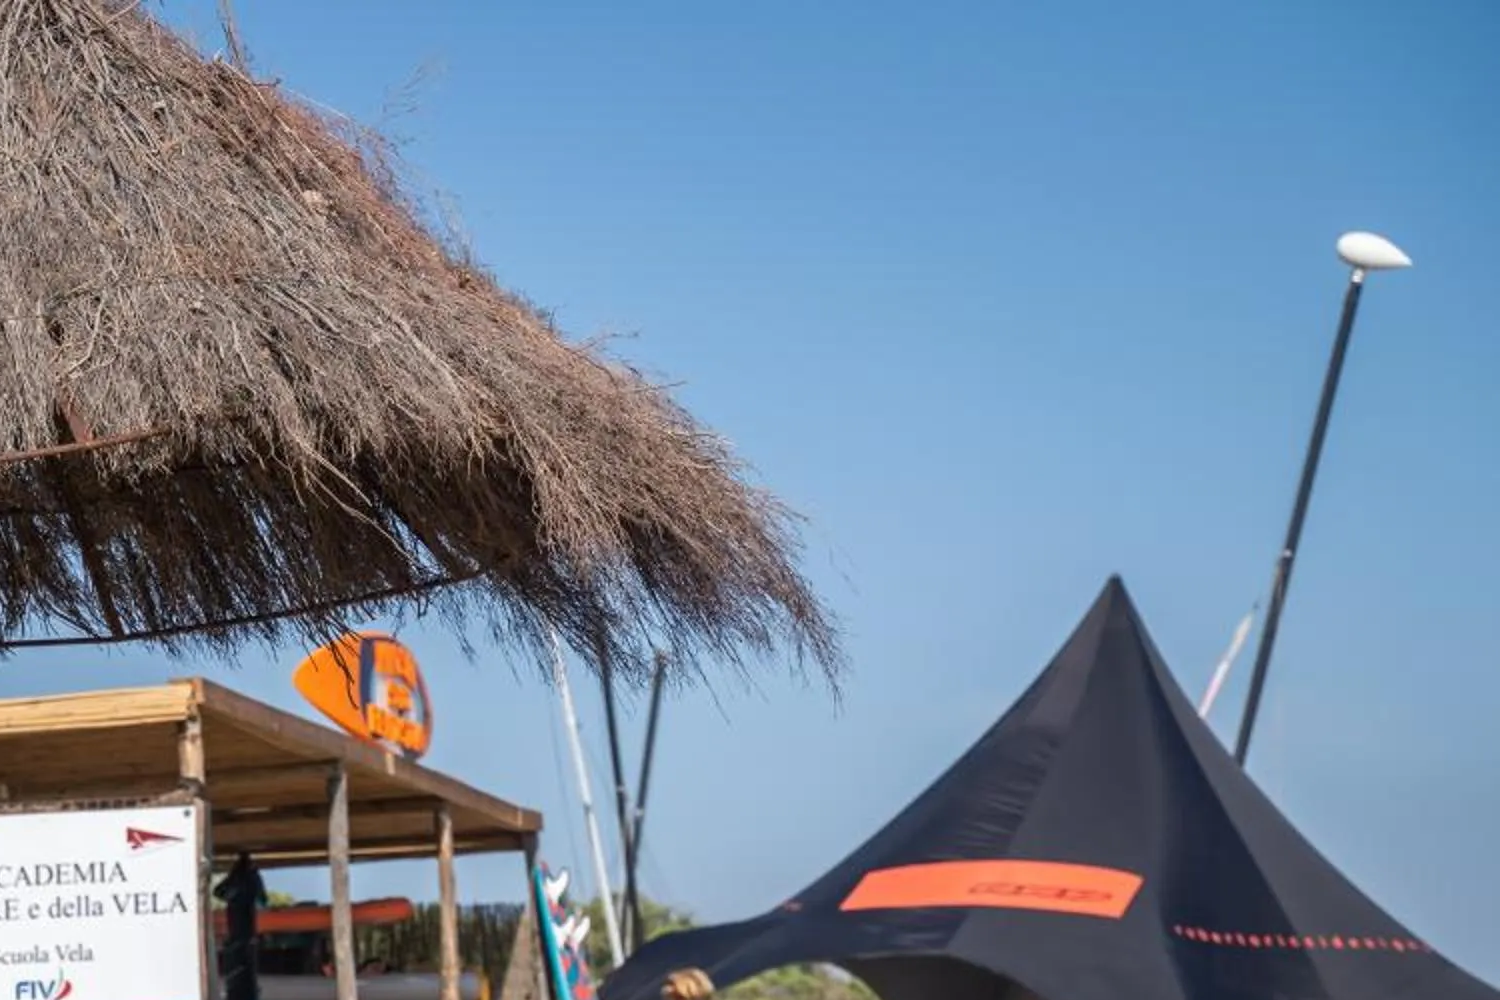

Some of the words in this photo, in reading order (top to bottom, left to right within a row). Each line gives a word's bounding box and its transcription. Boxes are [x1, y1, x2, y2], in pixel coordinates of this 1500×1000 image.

[28, 902, 41, 920] e
[47, 895, 104, 919] della
[112, 892, 188, 916] VELA
[55, 943, 94, 963] Vela
[15, 980, 56, 1000] FIV
